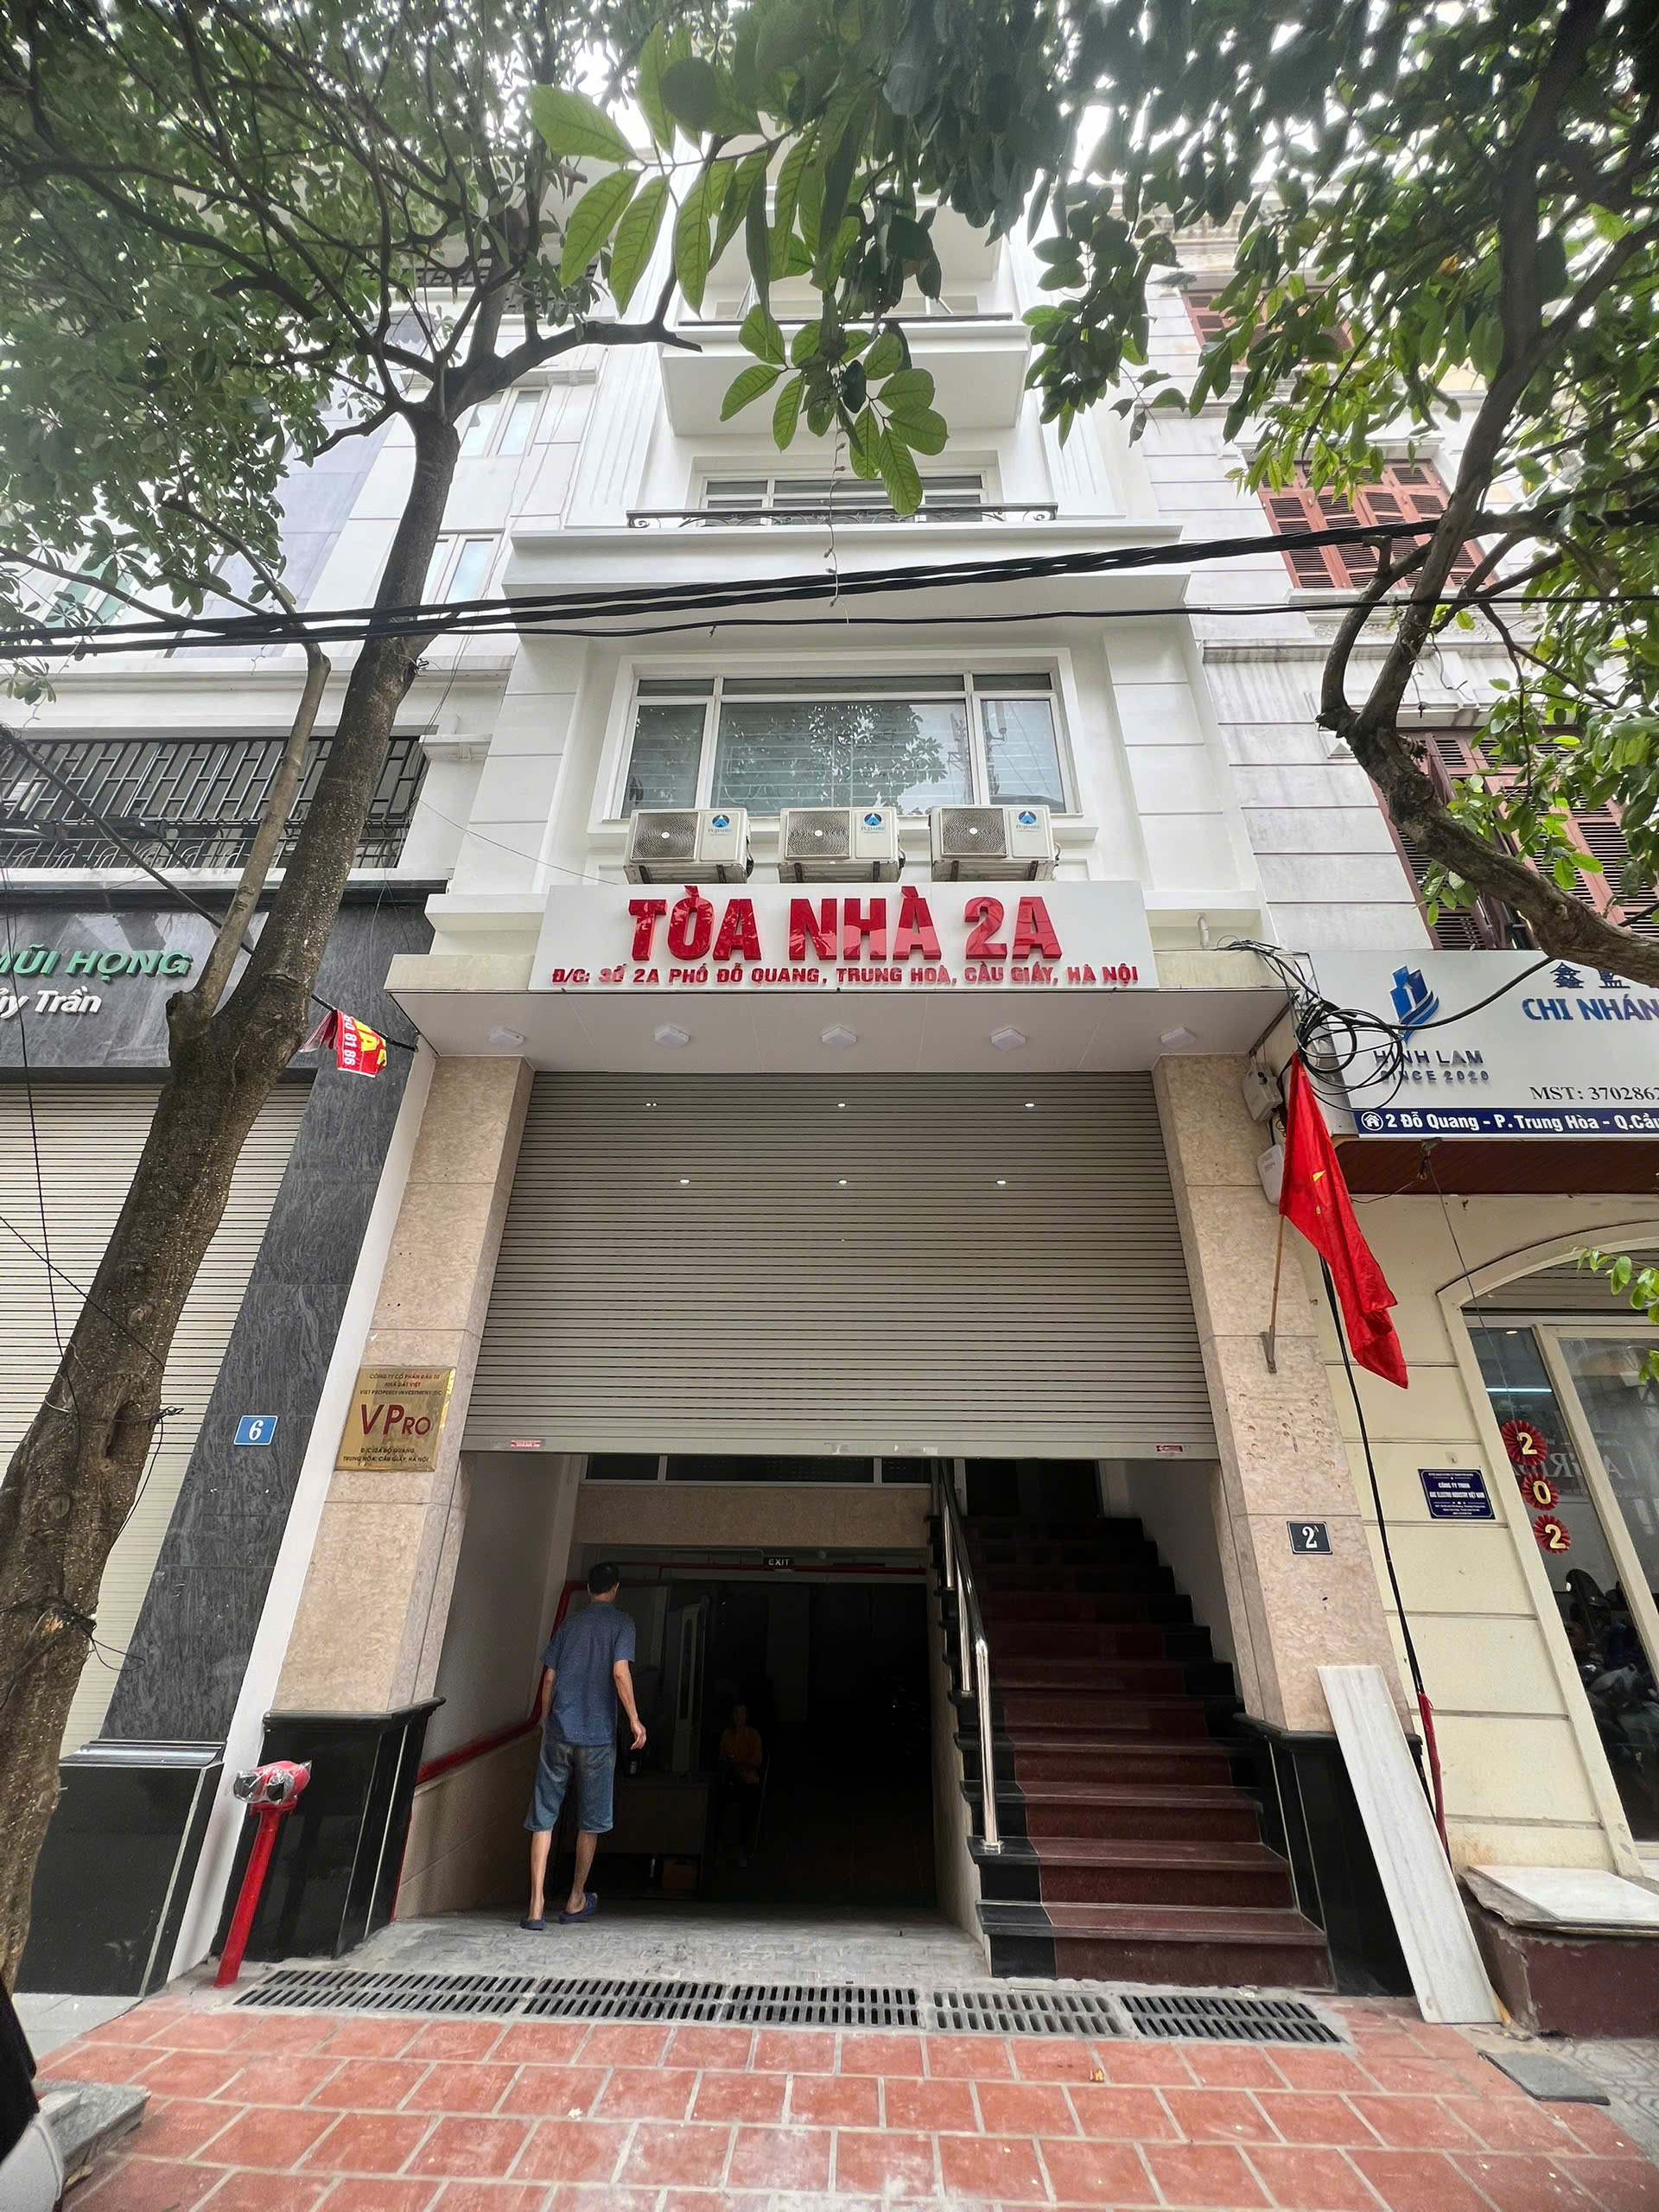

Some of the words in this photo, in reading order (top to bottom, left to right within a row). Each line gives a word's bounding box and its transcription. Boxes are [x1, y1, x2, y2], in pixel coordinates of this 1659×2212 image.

[628, 886, 762, 961] TÒA
[789, 886, 941, 961] NHÀ
[963, 896, 1063, 961] 2A
[66, 950, 194, 984] HỌNG
[632, 969, 659, 983] 2A
[669, 963, 709, 983] PHỐ
[836, 968, 902, 983] TRUNG
[1067, 963, 1096, 983] HÀ
[1102, 963, 1139, 986] NỘI
[35, 985, 103, 1014] Trần
[1522, 998, 1573, 1021] CHI
[1436, 1050, 1484, 1065] LAM
[1443, 1070, 1490, 1082] 2020
[1529, 1086, 1584, 1100] MST:
[1385, 1114, 1398, 1128] 2
[1401, 1111, 1424, 1128] Đỗ
[1427, 1114, 1480, 1131] Quang
[1513, 1115, 1564, 1132] Trung
[1565, 1114, 1600, 1129] Hòa
[248, 1420, 264, 1441] 6
